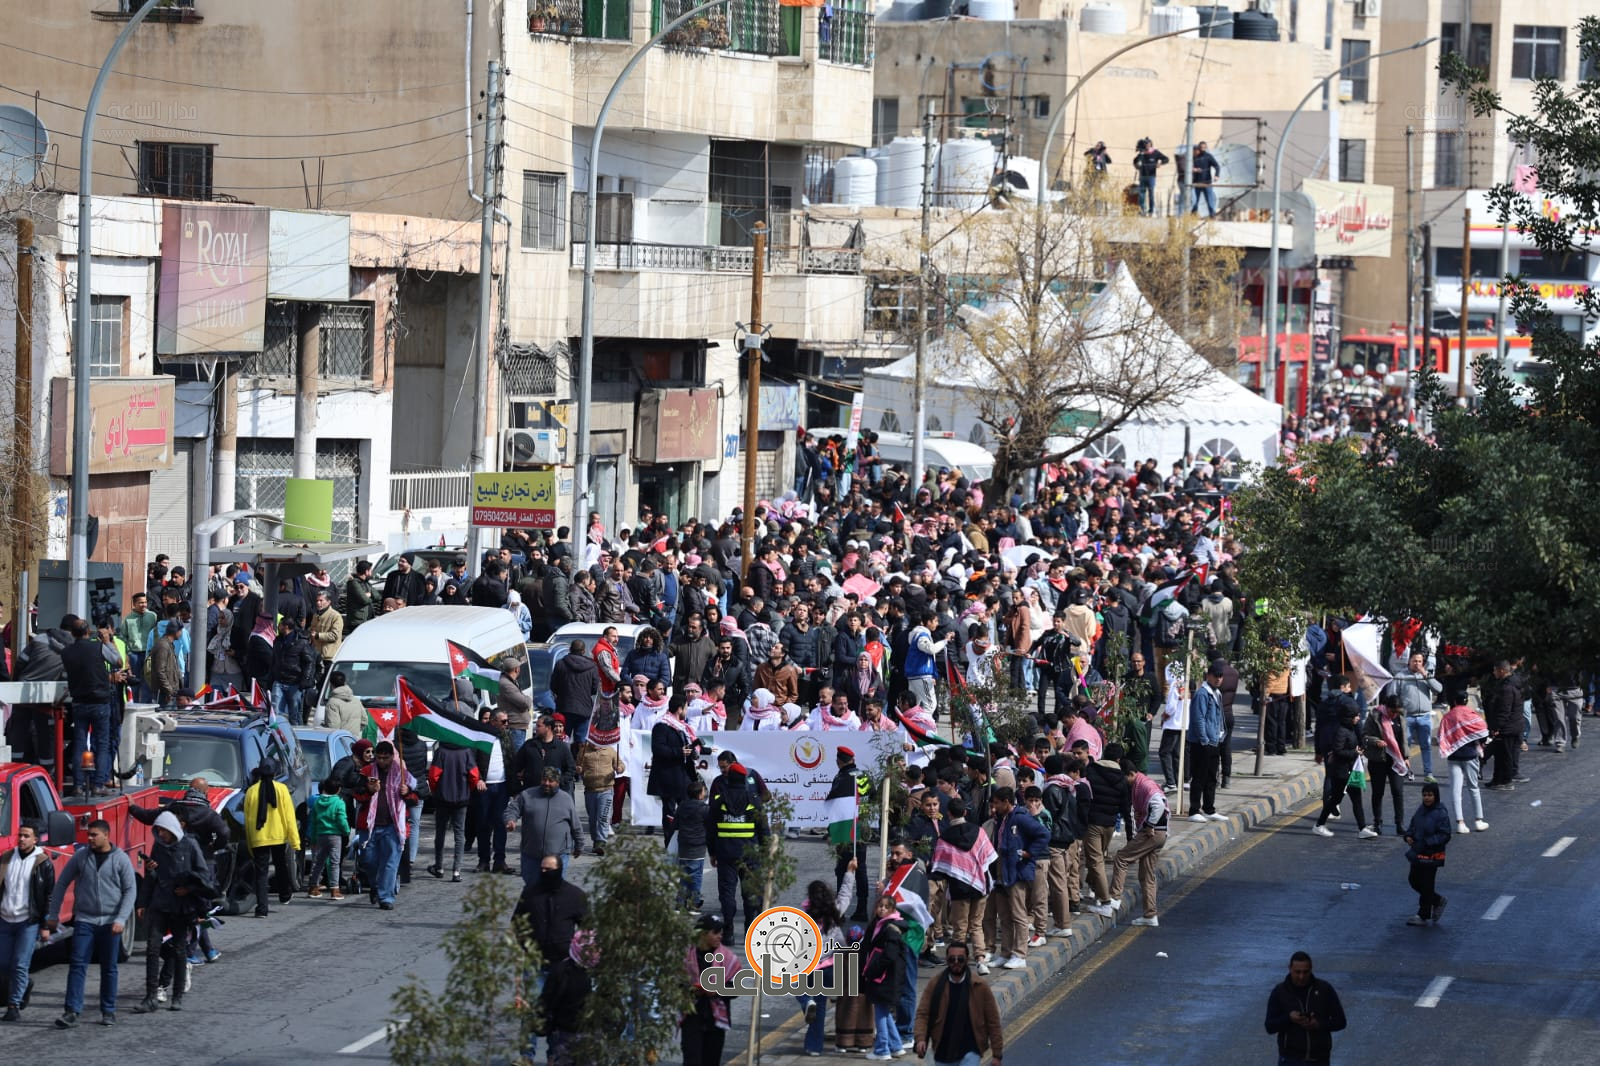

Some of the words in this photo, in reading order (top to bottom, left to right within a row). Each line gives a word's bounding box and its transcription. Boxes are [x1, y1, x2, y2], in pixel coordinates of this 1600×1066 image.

[476, 482, 500, 502] للبيع
[501, 482, 530, 502] تجاري
[531, 481, 552, 502] أرض
[474, 510, 517, 523] 0795042344
[803, 774, 833, 787] ستشفى
[723, 814, 746, 823] POLICE
